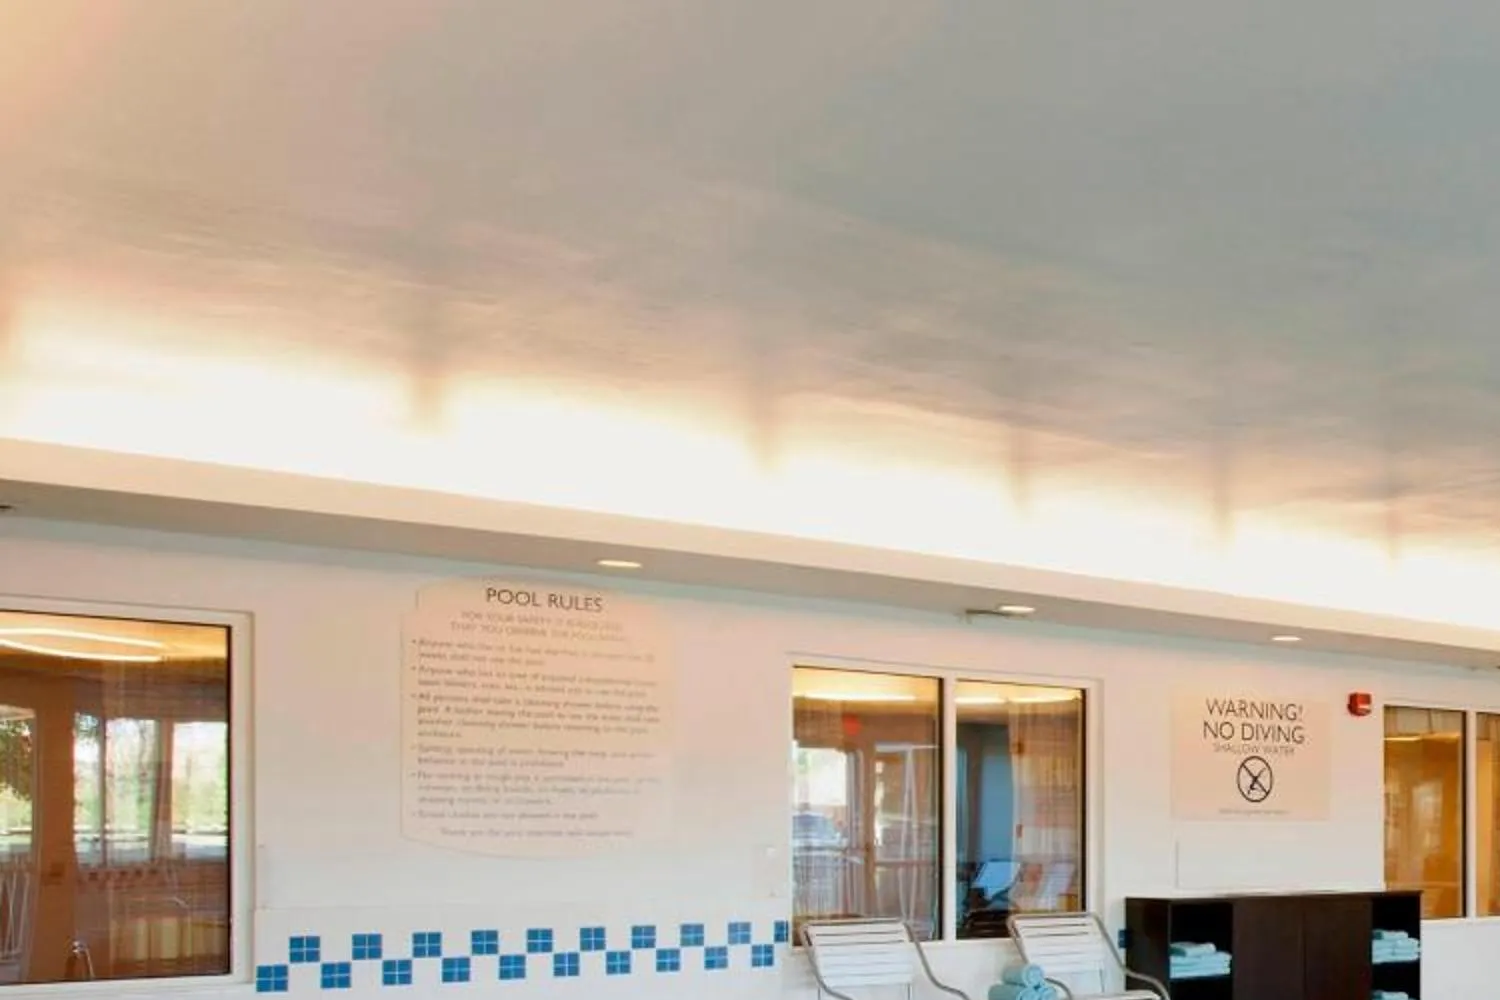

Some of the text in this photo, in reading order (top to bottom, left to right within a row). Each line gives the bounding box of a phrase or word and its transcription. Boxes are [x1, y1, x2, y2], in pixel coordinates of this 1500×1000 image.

[486, 587, 604, 612] POOL RULES
[1205, 697, 1303, 721] WARNING!
[1203, 720, 1305, 744] NO DIVING
